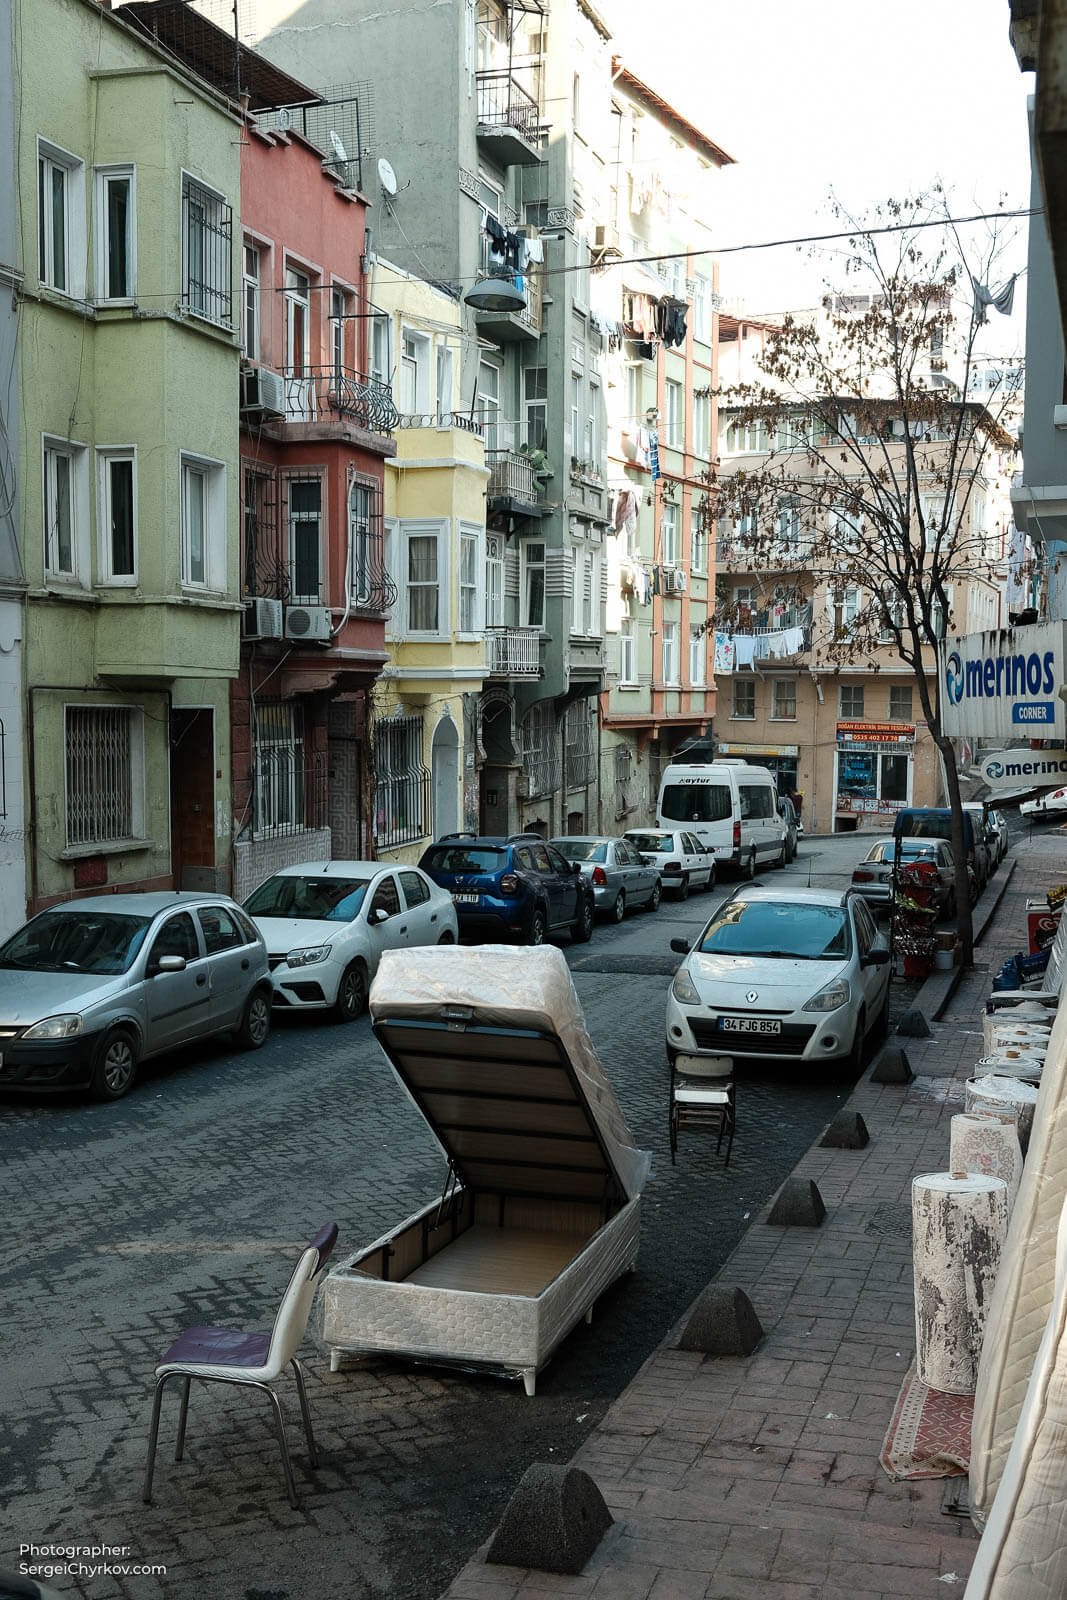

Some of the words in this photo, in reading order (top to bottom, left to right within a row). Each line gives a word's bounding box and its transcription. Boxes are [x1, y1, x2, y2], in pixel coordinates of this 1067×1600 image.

[966, 651, 1054, 697] merinos
[1019, 706, 1047, 720] CORNER
[725, 1019, 736, 1030] 34
[739, 1020, 758, 1031] FJG
[760, 1022, 778, 1032] 854
